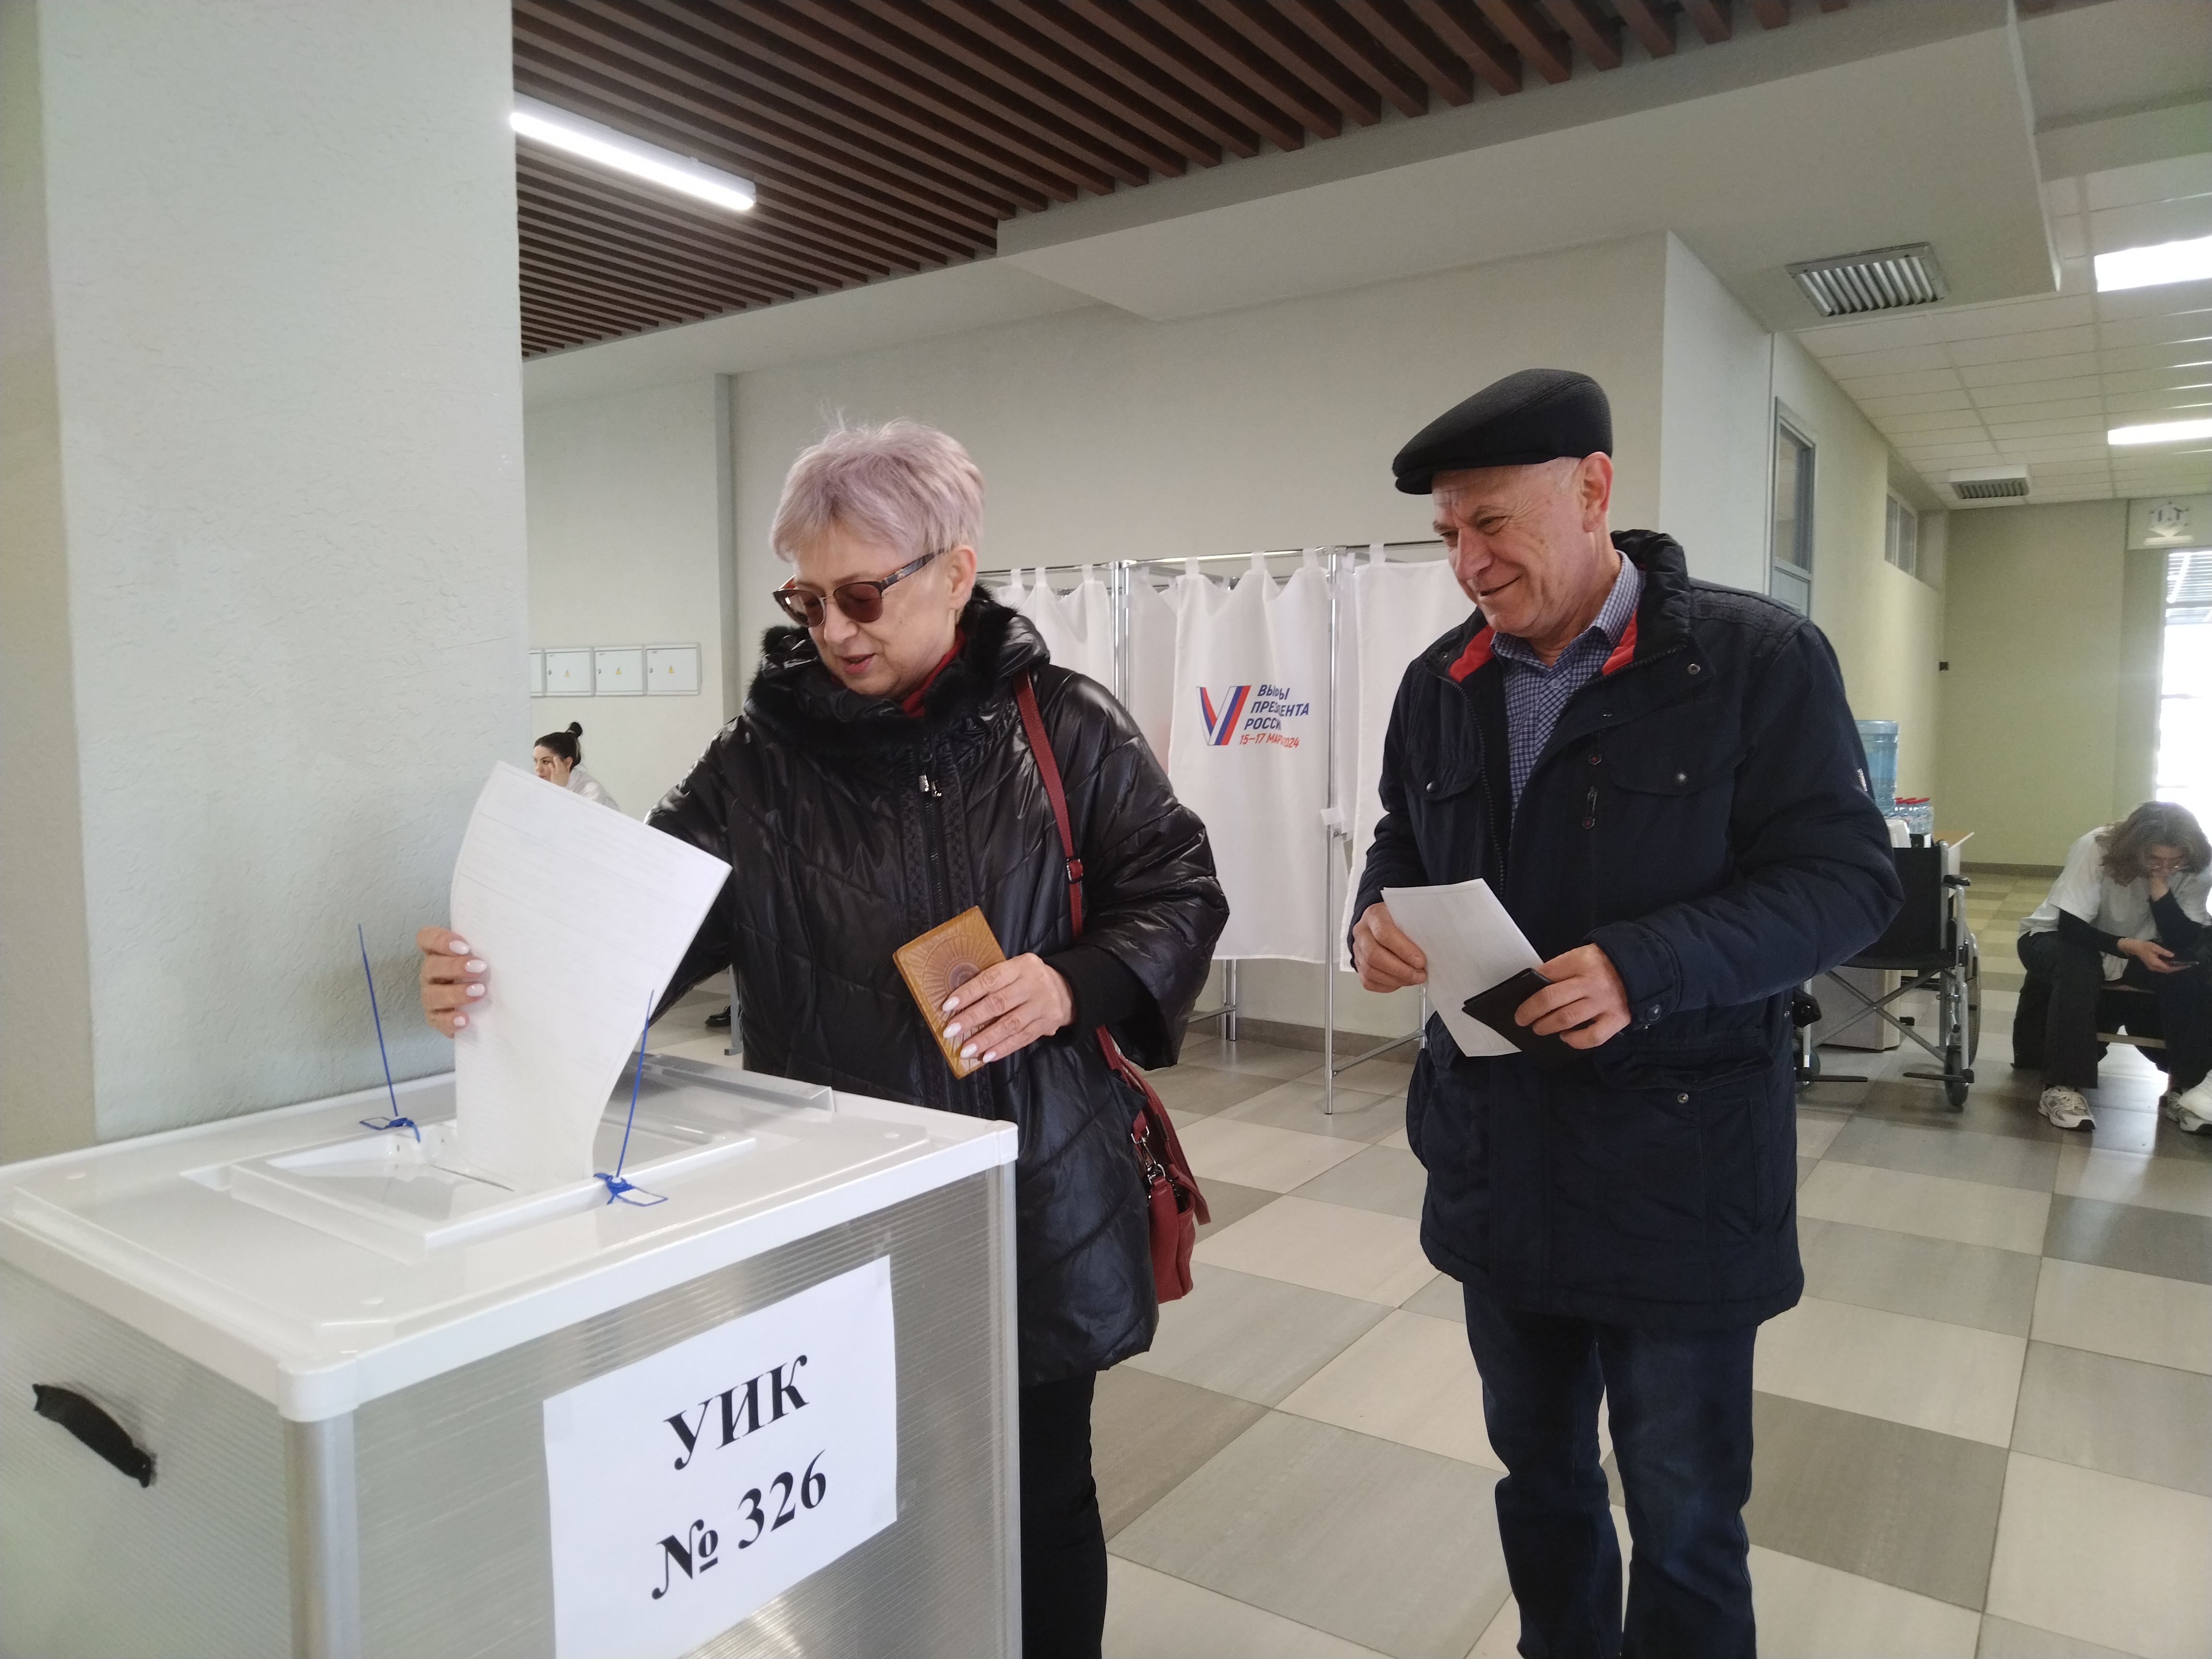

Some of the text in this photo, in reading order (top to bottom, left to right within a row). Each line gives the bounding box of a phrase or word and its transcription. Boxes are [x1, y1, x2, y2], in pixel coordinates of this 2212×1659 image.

[663, 1354, 810, 1470] УИК
[651, 1448, 827, 1600] № 326
